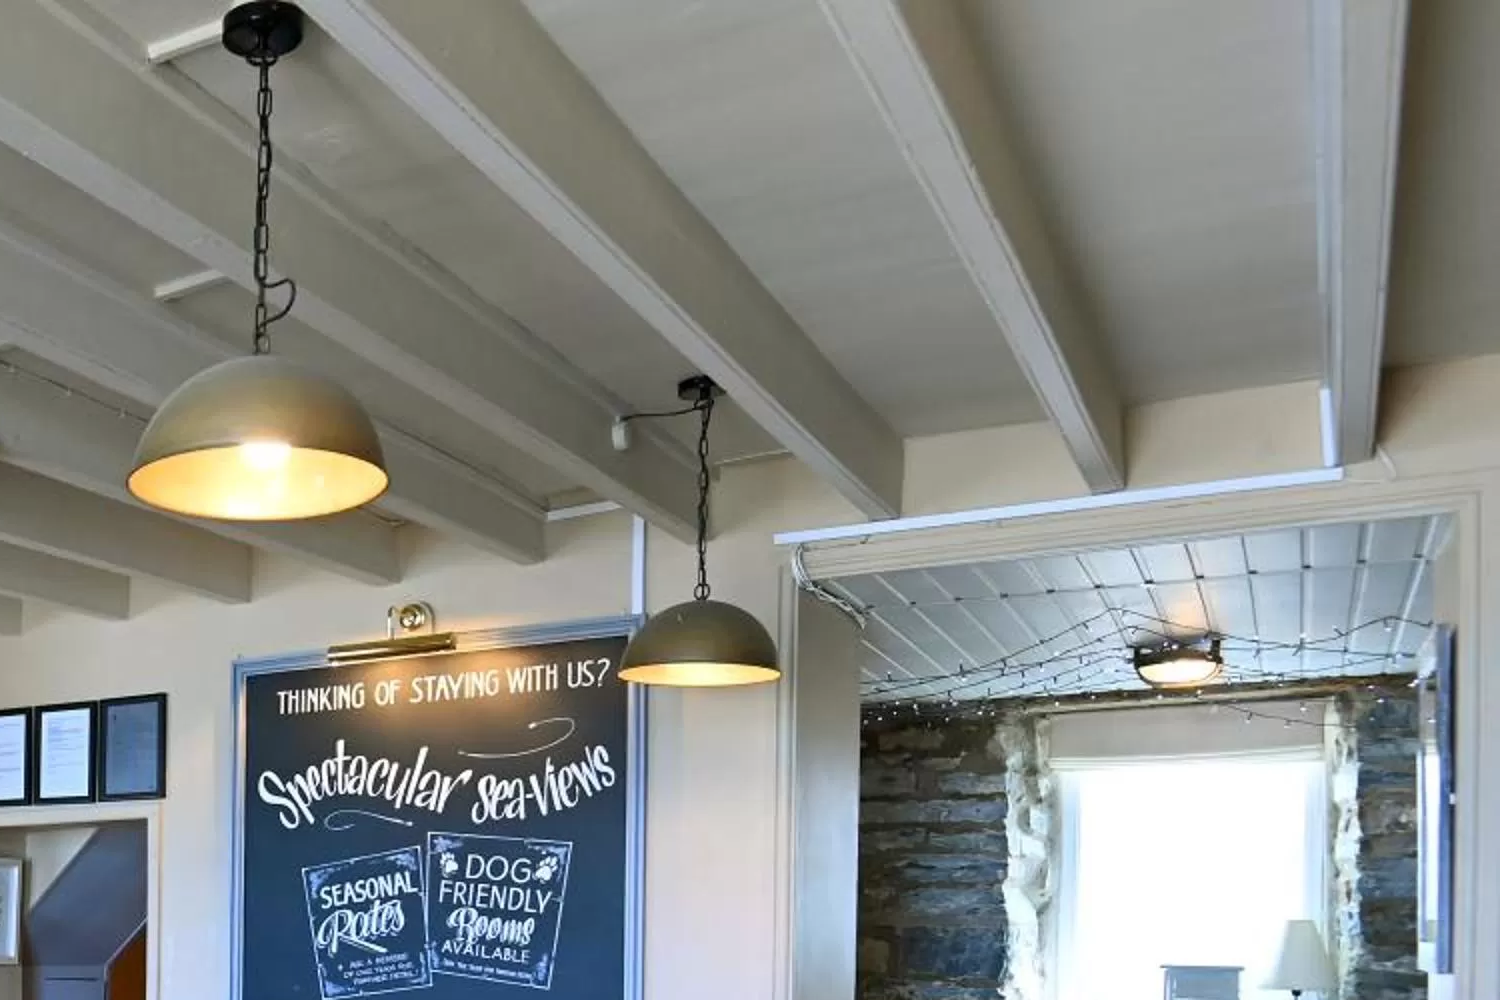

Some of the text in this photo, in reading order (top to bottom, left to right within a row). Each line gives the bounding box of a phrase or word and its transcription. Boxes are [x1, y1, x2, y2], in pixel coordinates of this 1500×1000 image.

[277, 658, 610, 715] THINKING OF STAYING WITH US?
[257, 739, 472, 830] Spectacular
[465, 854, 532, 883] DOG
[320, 871, 418, 909] SEASONAL
[439, 880, 552, 914] FRIENDLY
[317, 900, 405, 958] Rates
[446, 907, 535, 945] Rooms
[441, 940, 531, 964] AVAILABLE
